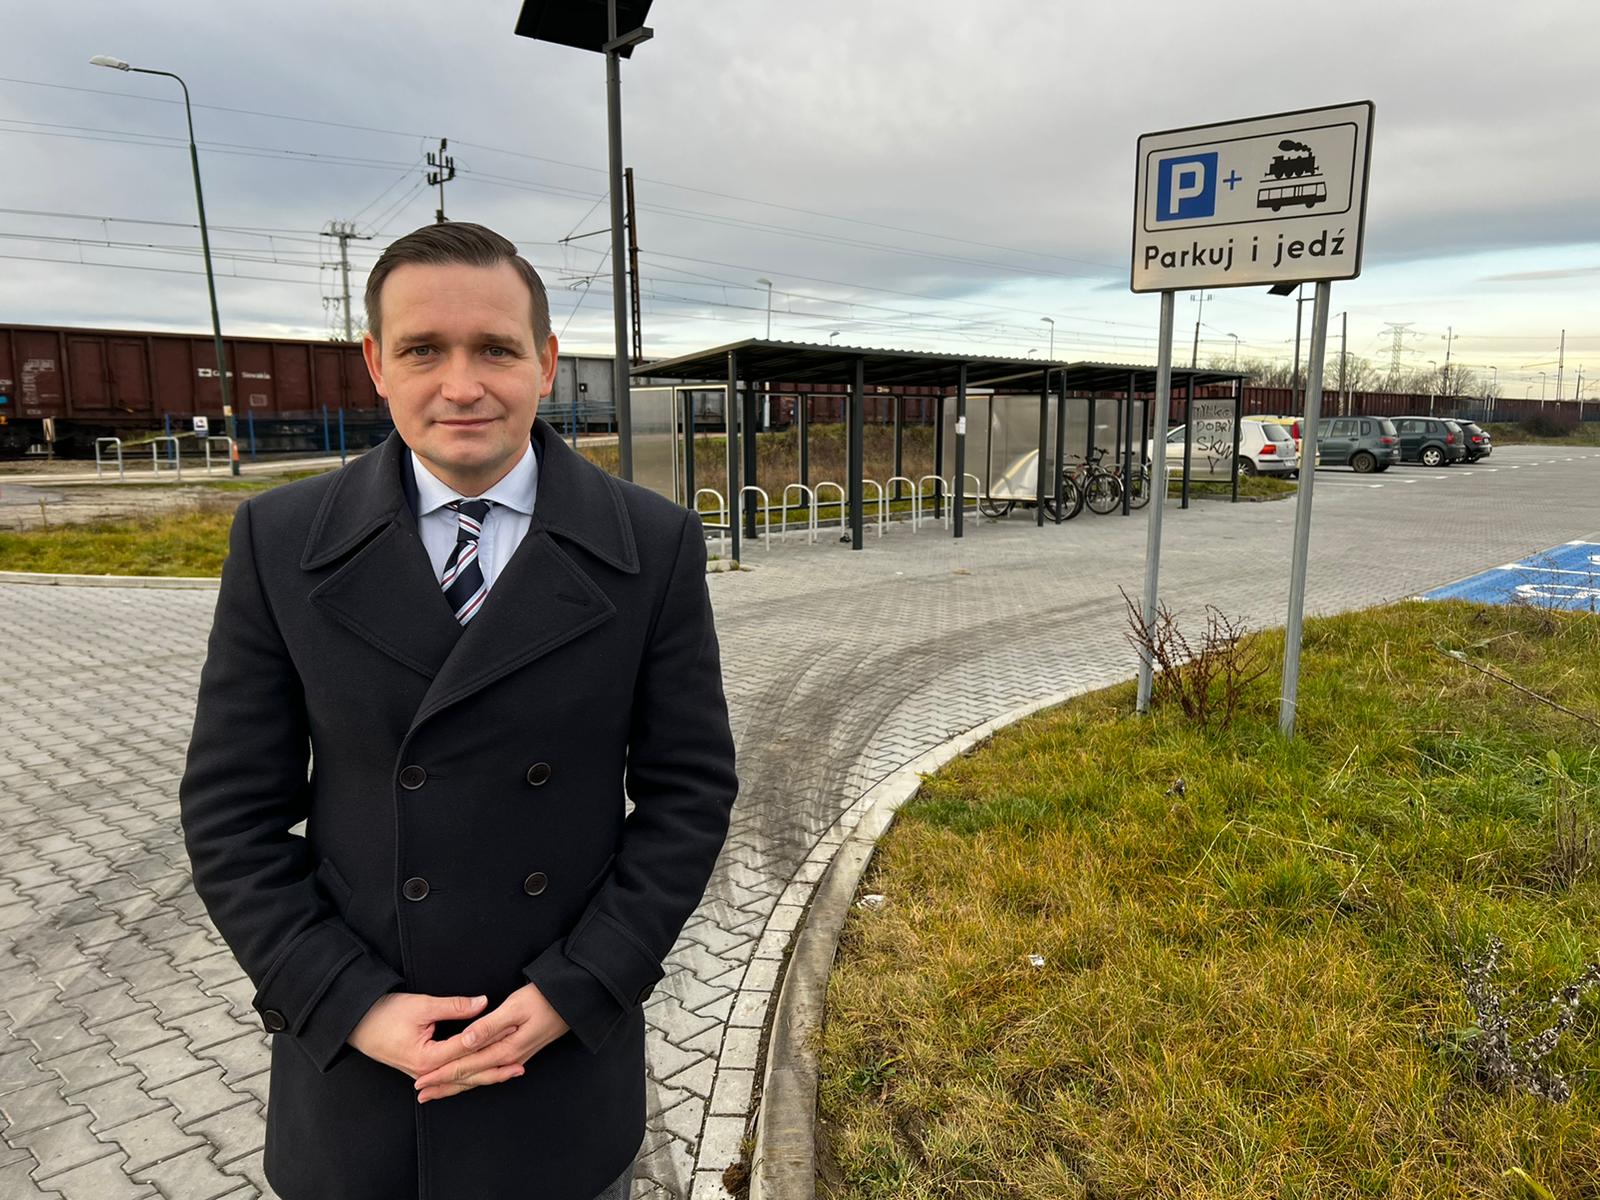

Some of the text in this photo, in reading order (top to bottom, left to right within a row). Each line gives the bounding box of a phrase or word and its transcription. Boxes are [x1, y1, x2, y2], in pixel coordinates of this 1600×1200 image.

[1169, 161, 1205, 215] P
[1144, 228, 1345, 272] Parkuj i jedź
[1196, 419, 1233, 433] DOBRY
